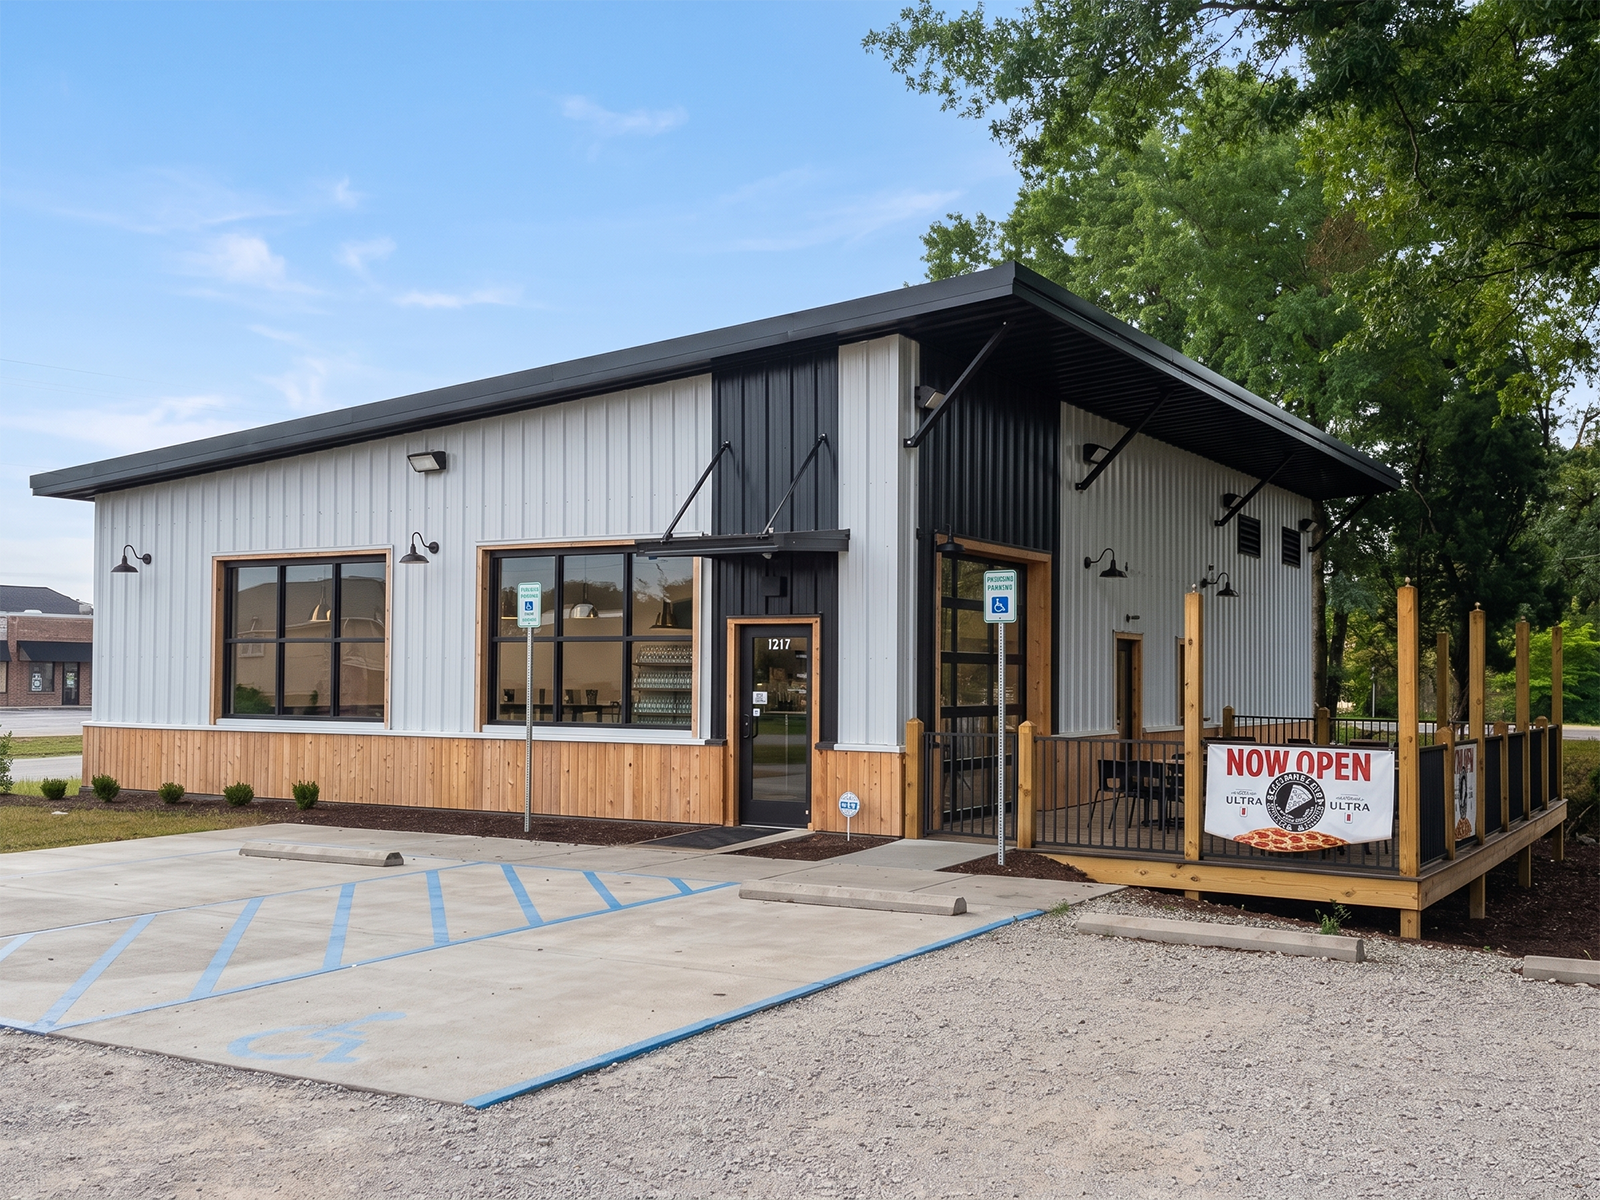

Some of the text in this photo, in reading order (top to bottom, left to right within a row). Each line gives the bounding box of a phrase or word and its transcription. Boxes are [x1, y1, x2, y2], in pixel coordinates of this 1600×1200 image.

[768, 638, 791, 650] 1217
[1226, 748, 1371, 782] NOW OPEN
[1226, 795, 1263, 806] ULTRA
[1330, 801, 1371, 812] ULTRA
